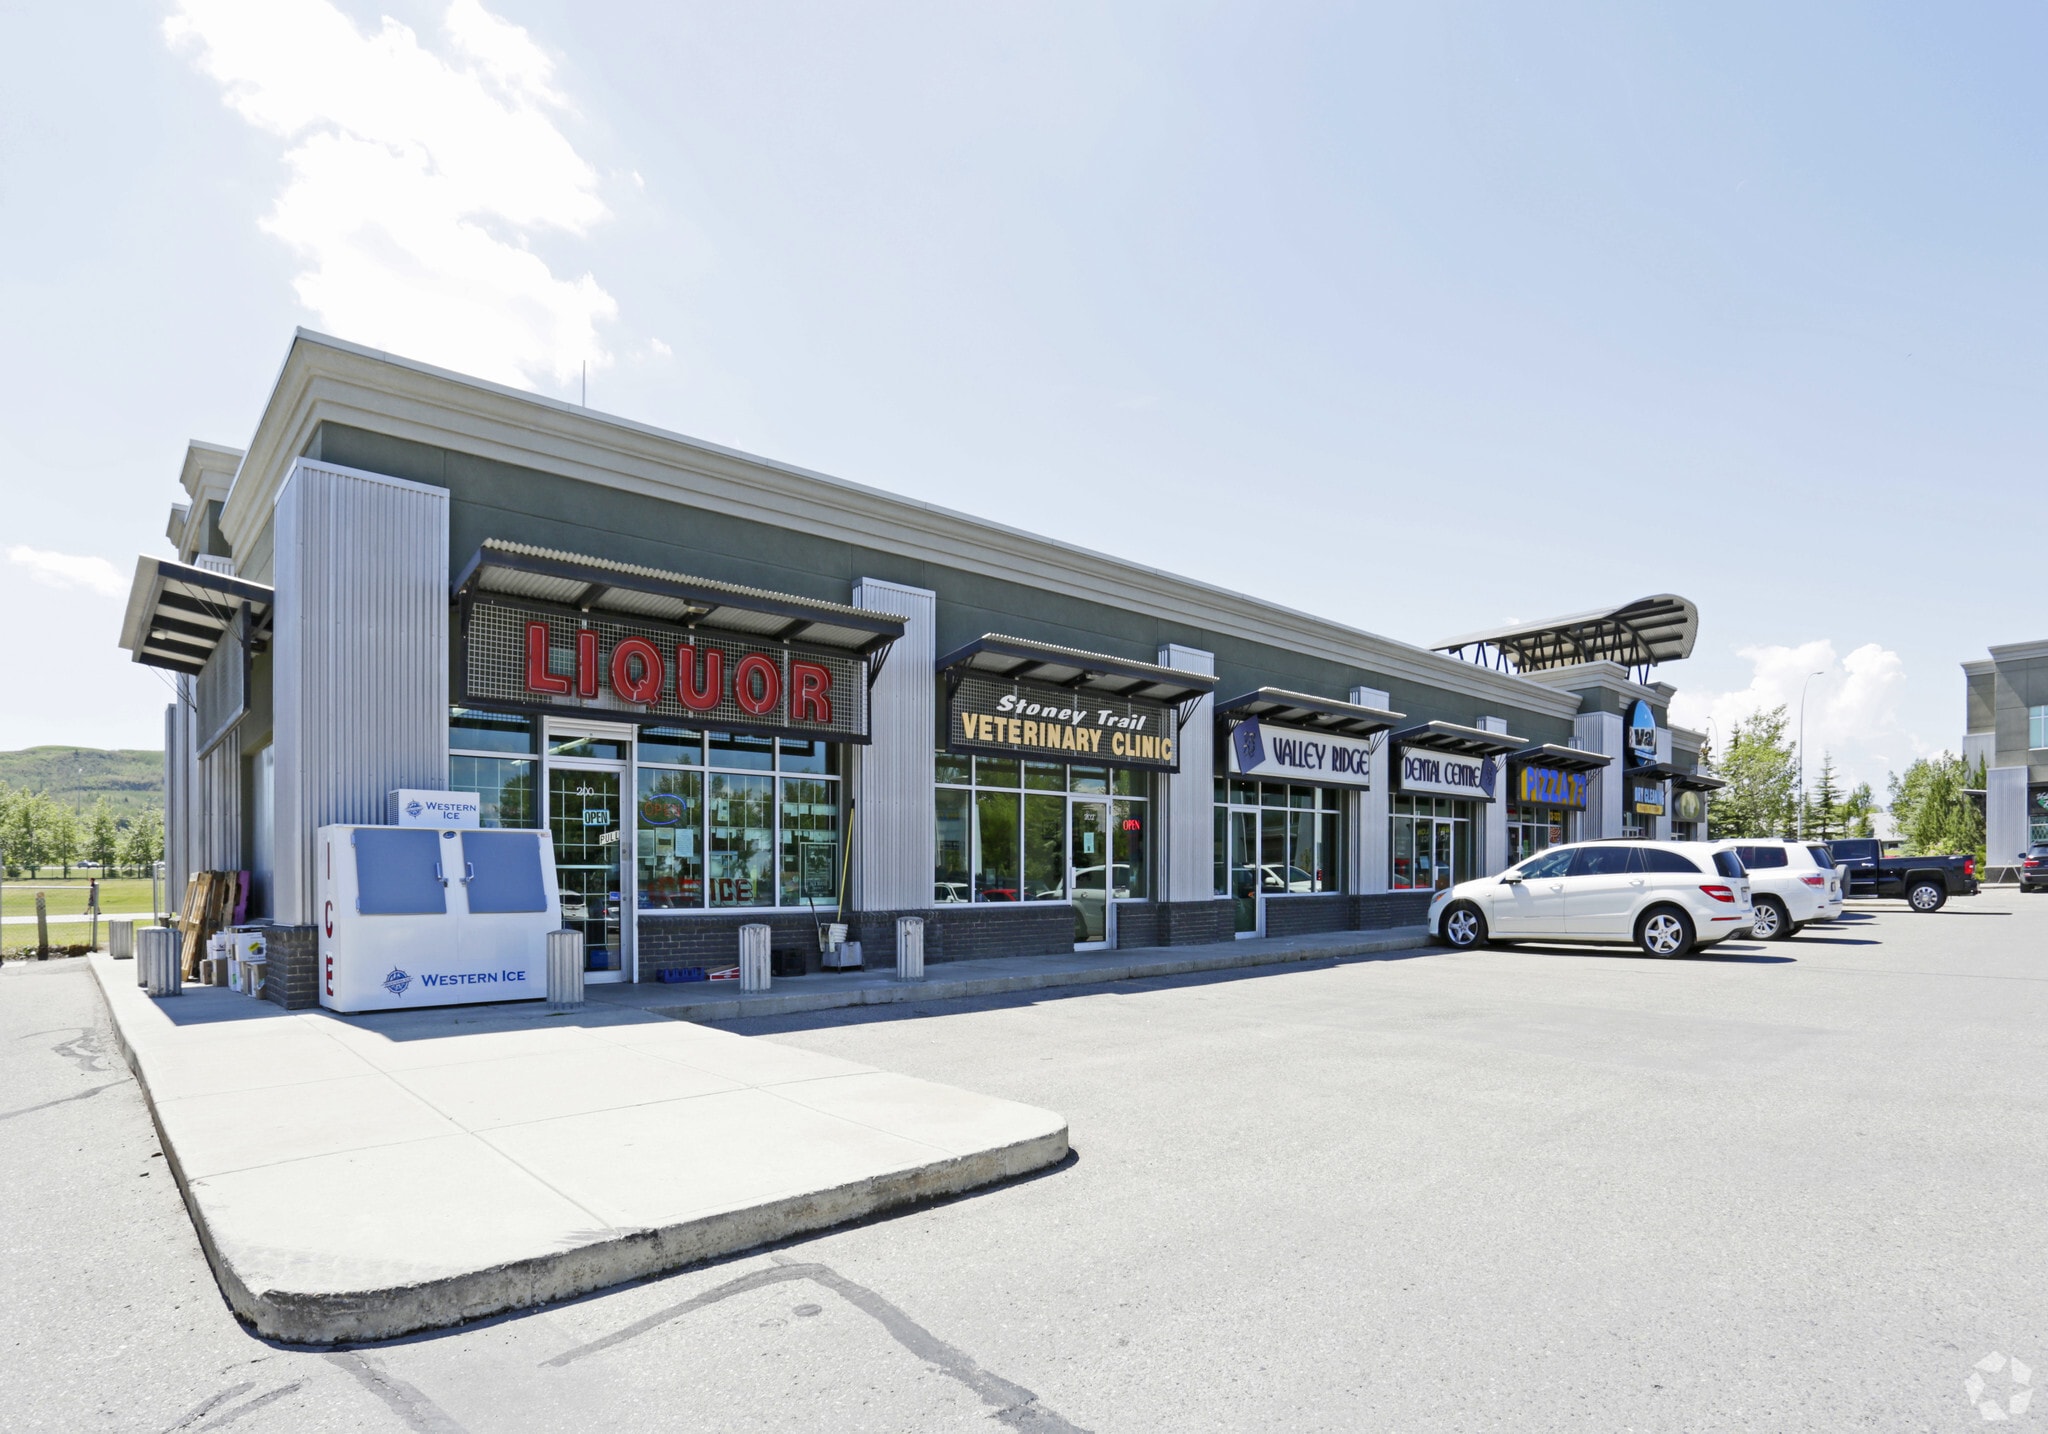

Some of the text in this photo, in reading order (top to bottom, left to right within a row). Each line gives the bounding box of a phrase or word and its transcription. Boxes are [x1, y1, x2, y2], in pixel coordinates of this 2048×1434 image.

[526, 621, 833, 724] LIQUOR
[996, 695, 1147, 731] Stoney Trail
[961, 712, 1173, 761] VETERINARY CLINIC
[1273, 736, 1370, 776] VALLEY RIDGE
[1404, 756, 1481, 788] DENTAL CENTRE
[576, 787, 595, 797] 200
[1522, 766, 1569, 805] PIZZA
[426, 801, 477, 812] WESTERN
[443, 811, 460, 820] ICE
[644, 801, 682, 818] OPEN
[584, 811, 608, 824] OPEN
[1122, 819, 1140, 831] OPEN
[600, 833, 619, 845] PULL
[710, 878, 753, 902] ICE
[325, 842, 334, 997] ICE
[421, 970, 526, 987] WESTERN ICE
